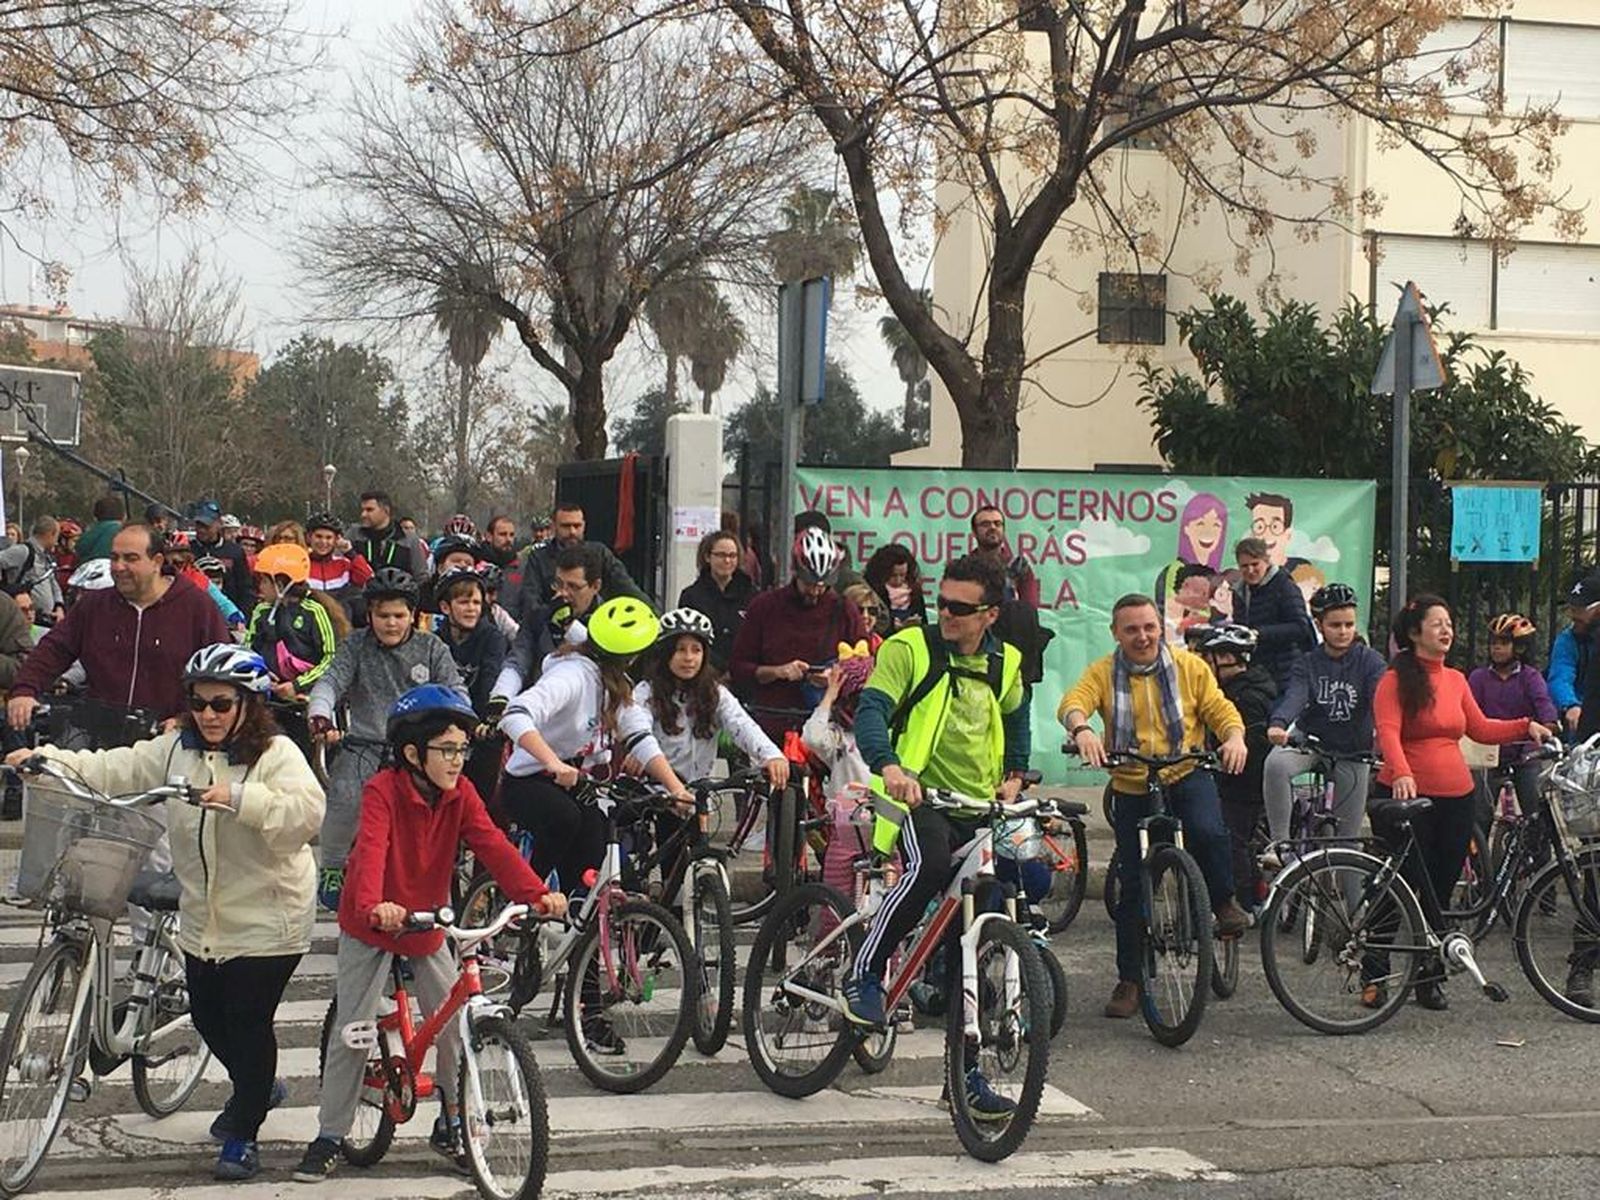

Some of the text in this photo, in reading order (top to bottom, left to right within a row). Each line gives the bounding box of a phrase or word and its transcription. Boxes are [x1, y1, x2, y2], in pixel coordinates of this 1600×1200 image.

[798, 484, 1177, 523] VEN A CONOCERNOS
